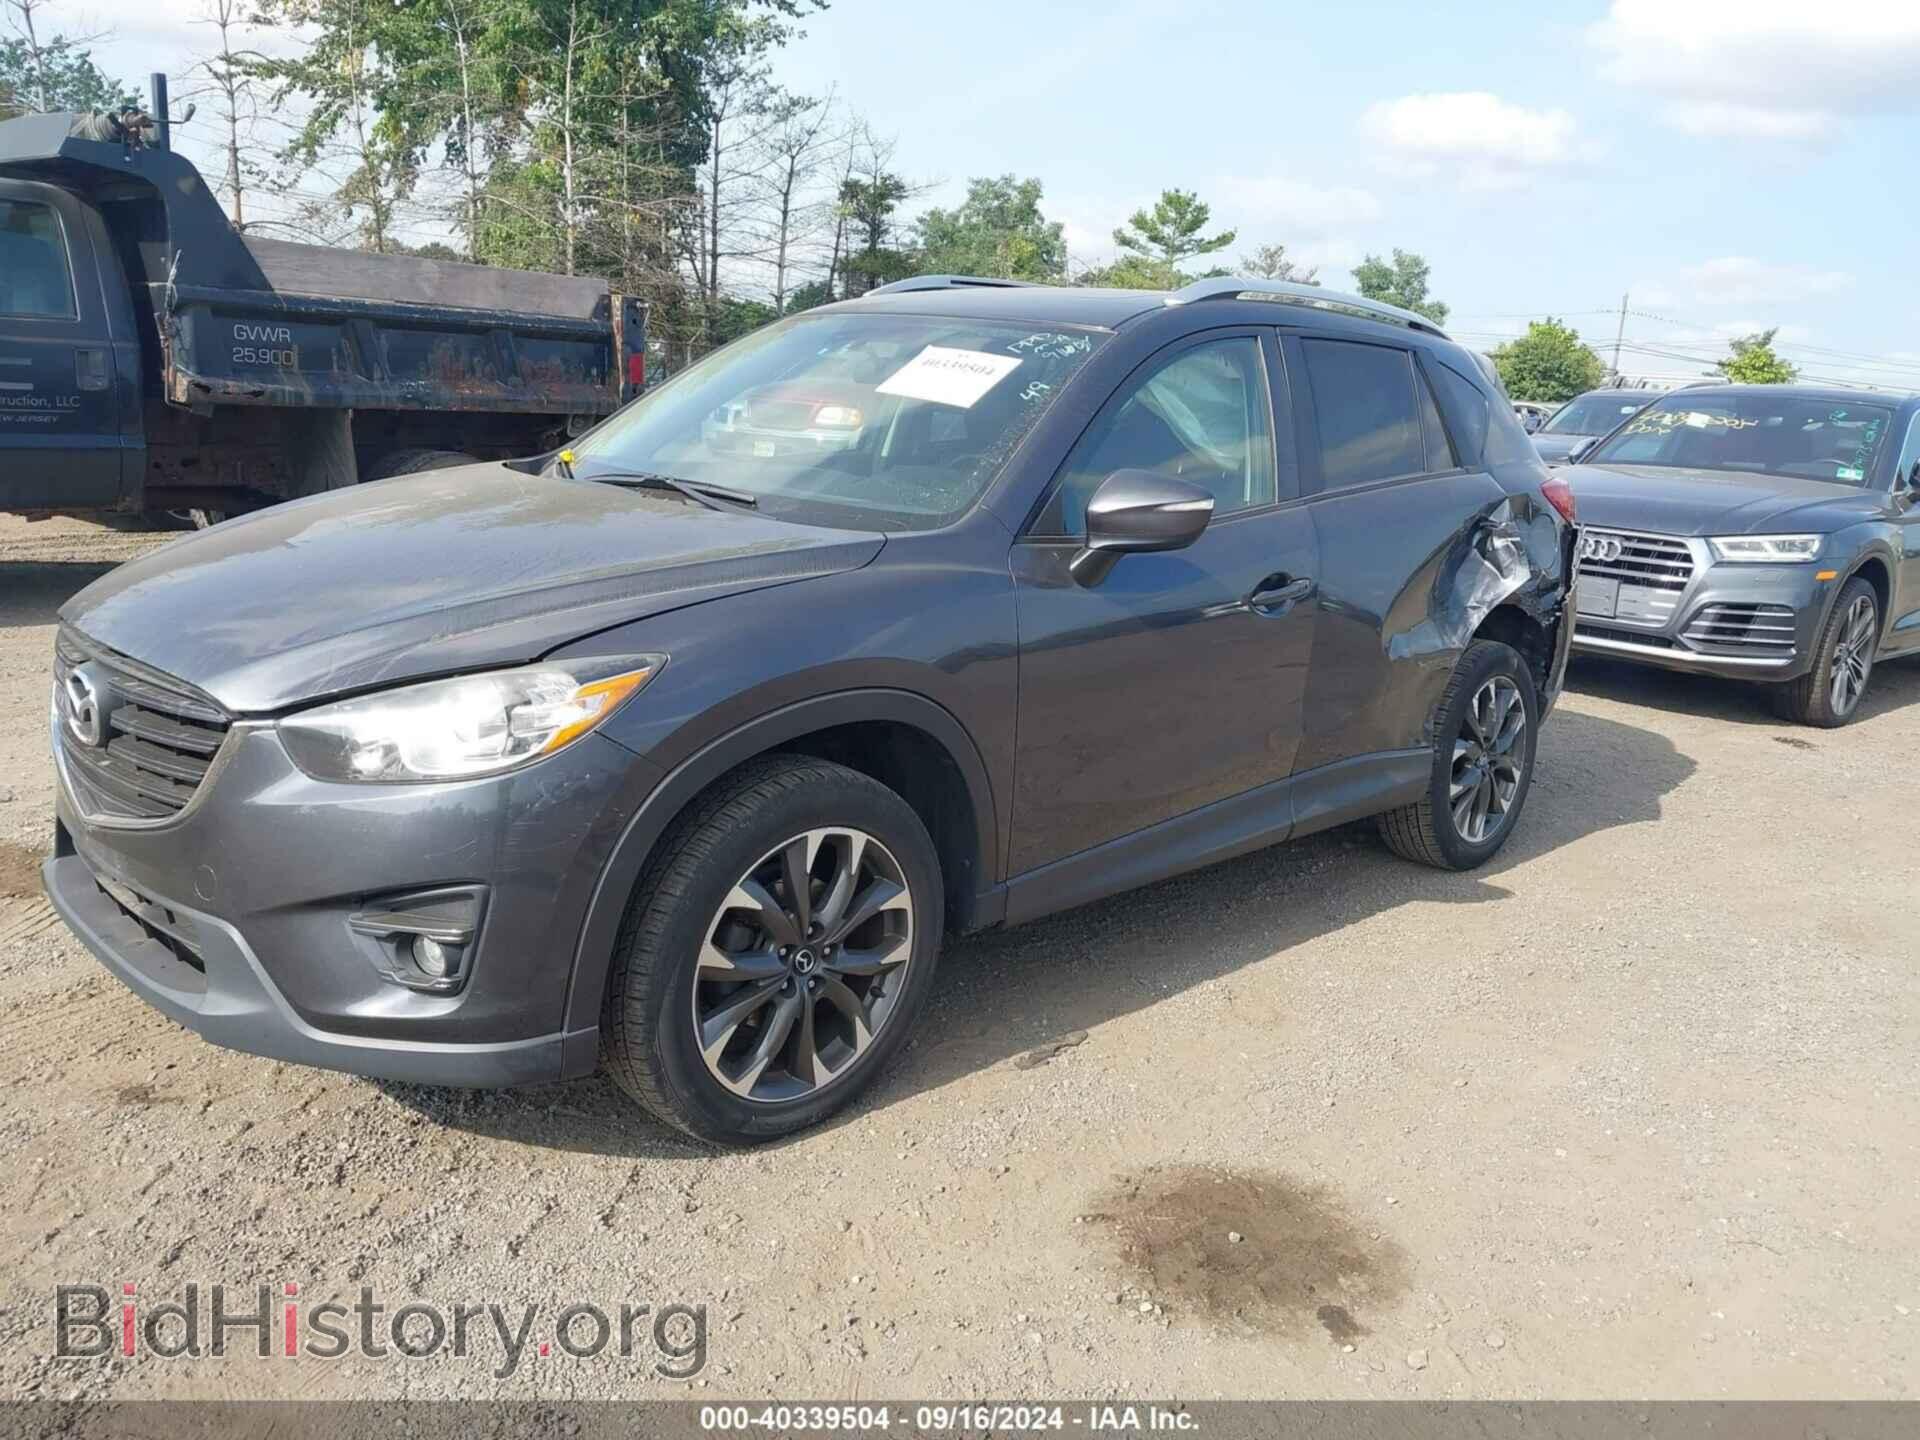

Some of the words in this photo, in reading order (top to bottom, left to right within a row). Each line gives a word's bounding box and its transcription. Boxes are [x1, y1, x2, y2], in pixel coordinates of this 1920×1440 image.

[233, 323, 291, 342] GVWR
[232, 346, 294, 366] 25,900
[56, 395, 81, 408] LLC
[15, 414, 59, 424] JERSEY
